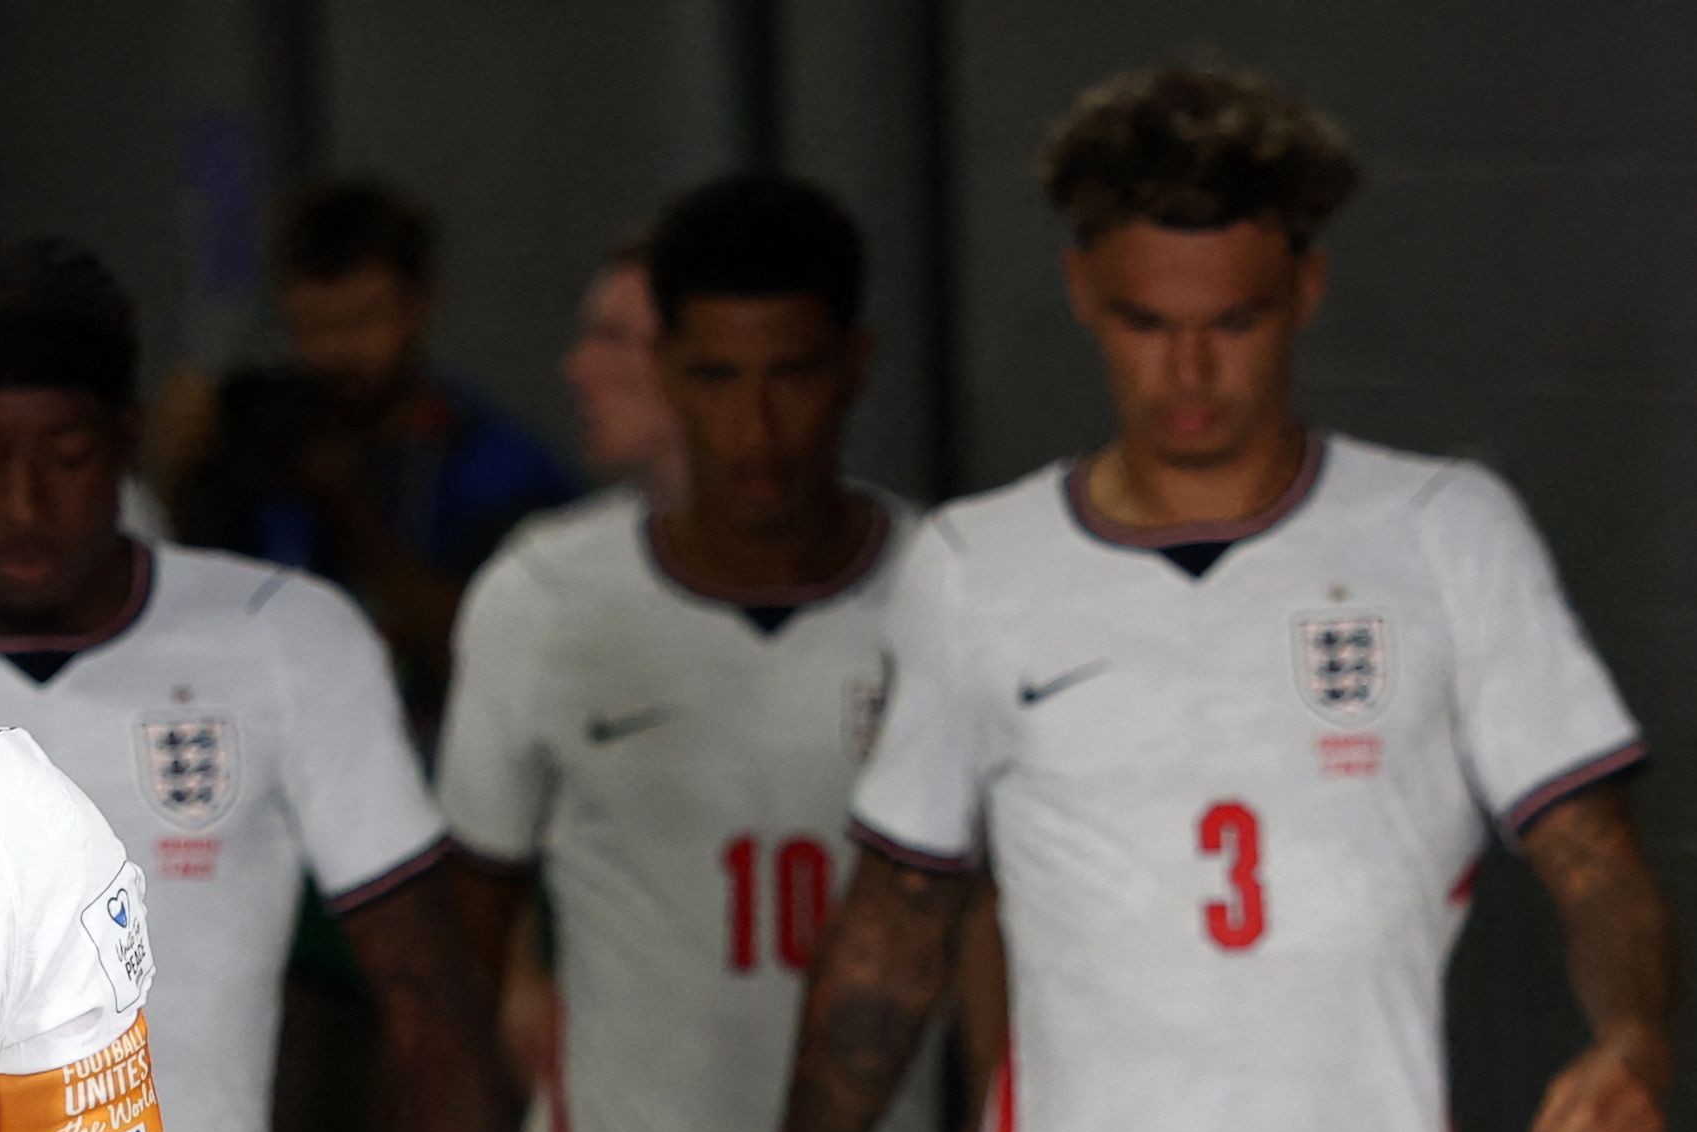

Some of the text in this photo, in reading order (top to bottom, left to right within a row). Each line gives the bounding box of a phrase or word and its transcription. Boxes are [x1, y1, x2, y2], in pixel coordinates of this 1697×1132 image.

[724, 834, 830, 971] 10
[1200, 803, 1263, 949] 3
[63, 1025, 146, 1084] FOOTBALL
[65, 1048, 149, 1116] UNITES
[107, 1078, 157, 1130] World
